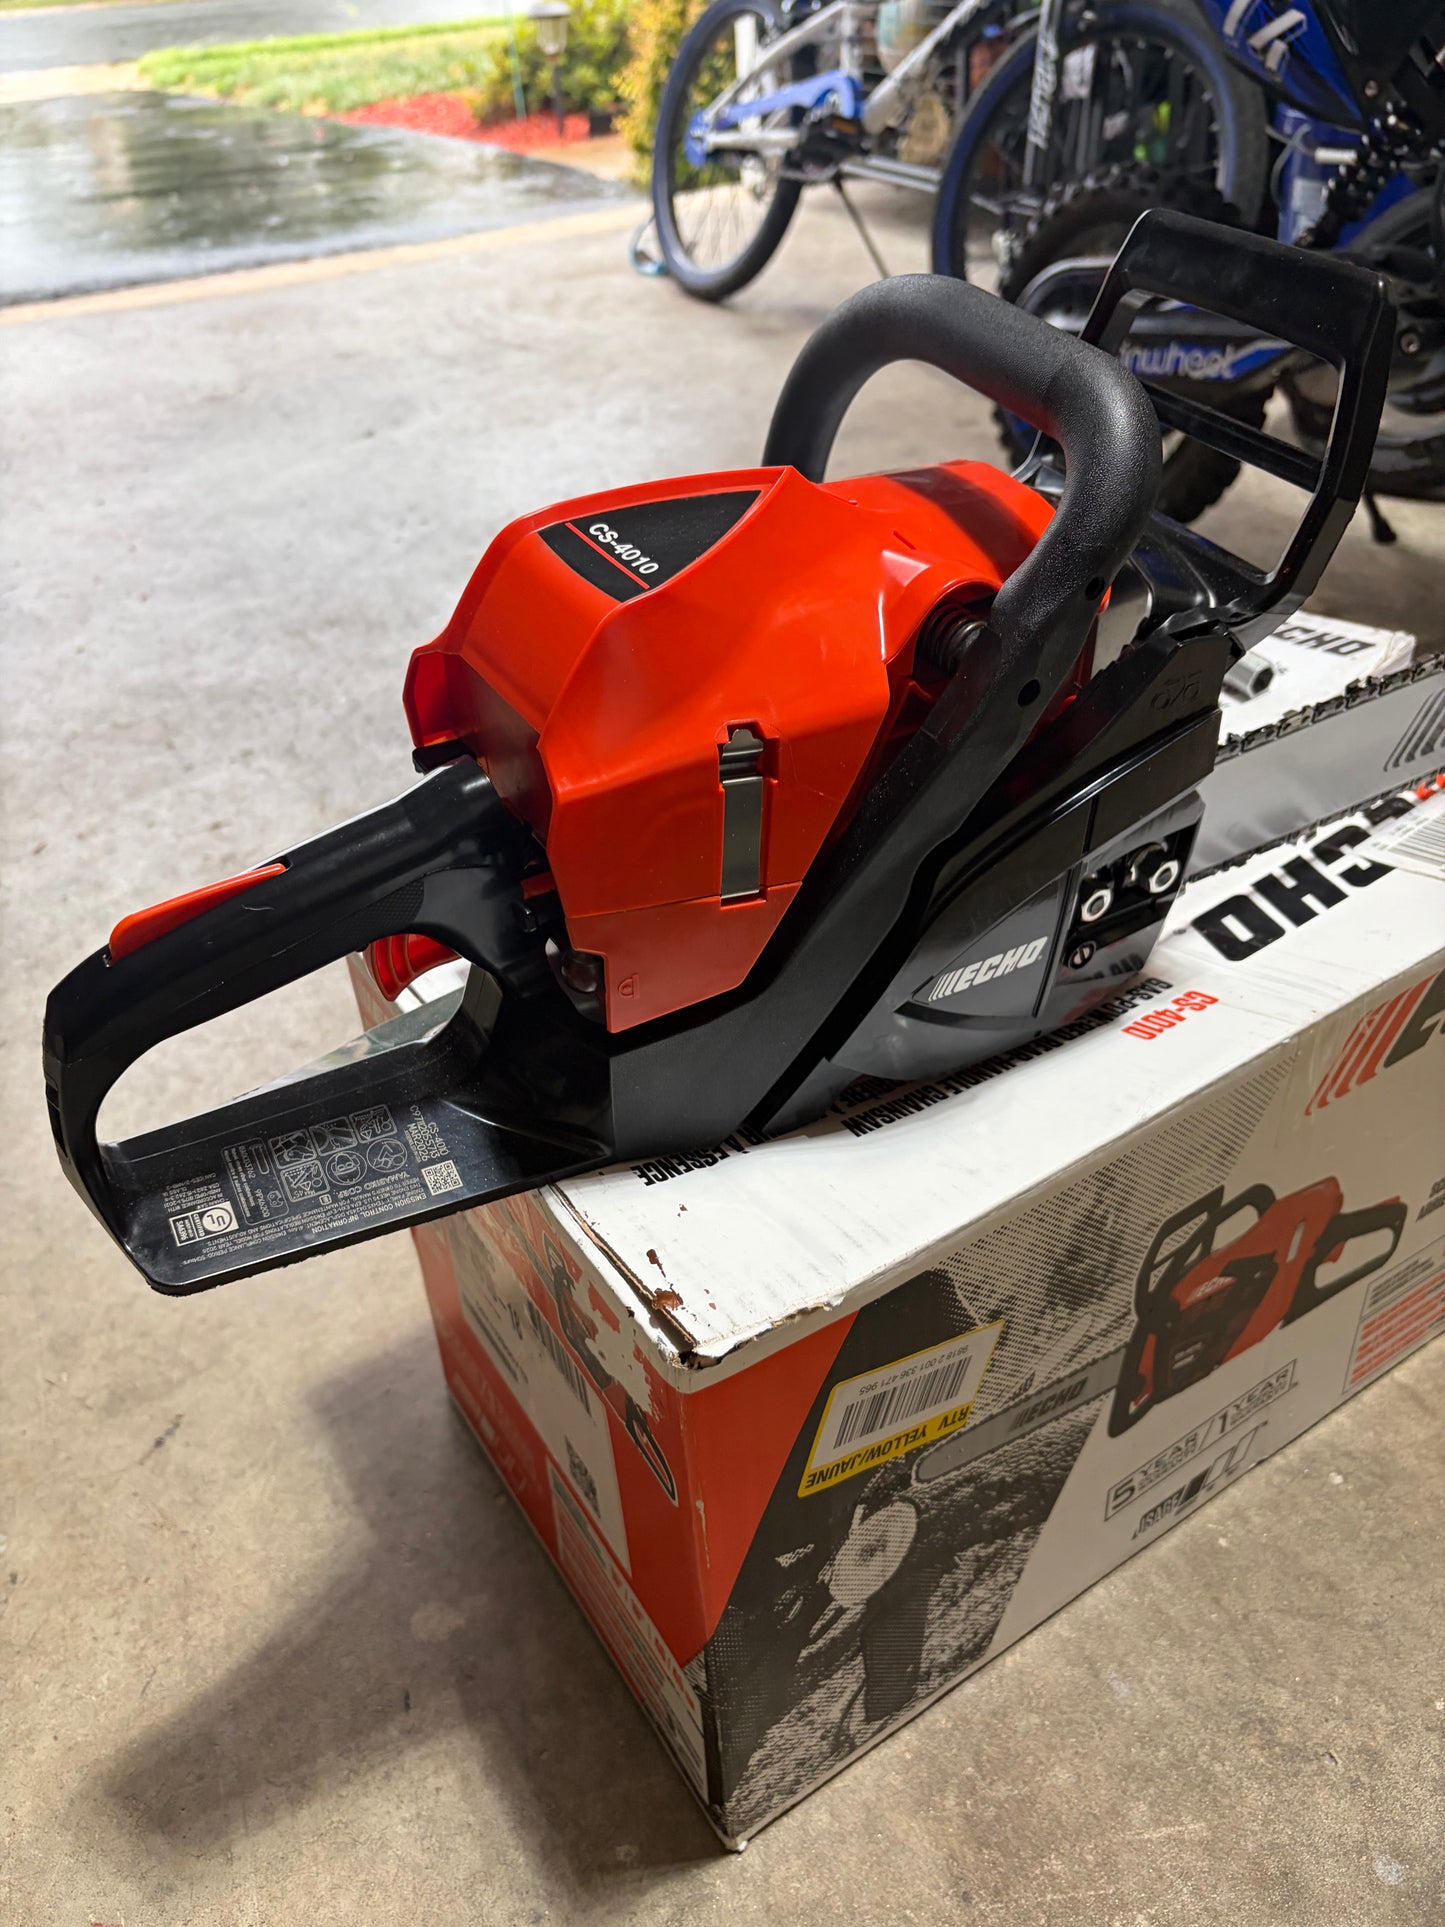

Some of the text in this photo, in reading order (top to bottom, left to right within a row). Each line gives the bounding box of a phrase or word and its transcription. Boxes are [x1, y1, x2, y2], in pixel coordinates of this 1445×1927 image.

[589, 523, 660, 575] CS-4010
[1273, 625, 1376, 656] CHO
[950, 936, 1048, 994] ECHO
[1122, 990, 1219, 1040] CS-4010
[841, 1084, 949, 1137] CHAINSAW
[407, 1123, 430, 1162] MAR2026
[428, 1122, 449, 1156] CS-4010
[310, 1212, 360, 1235] INFORMATION
[880, 1374, 898, 1388] 471
[899, 1366, 918, 1380] 336
[919, 1358, 937, 1372] 001
[859, 1382, 878, 1397] 965
[804, 1404, 972, 1489] RTV YELLOW/JAUNE
[1111, 1476, 1137, 1512] 5
[1139, 1431, 1199, 1478] YEAR
[1232, 1367, 1290, 1412] YEAR
